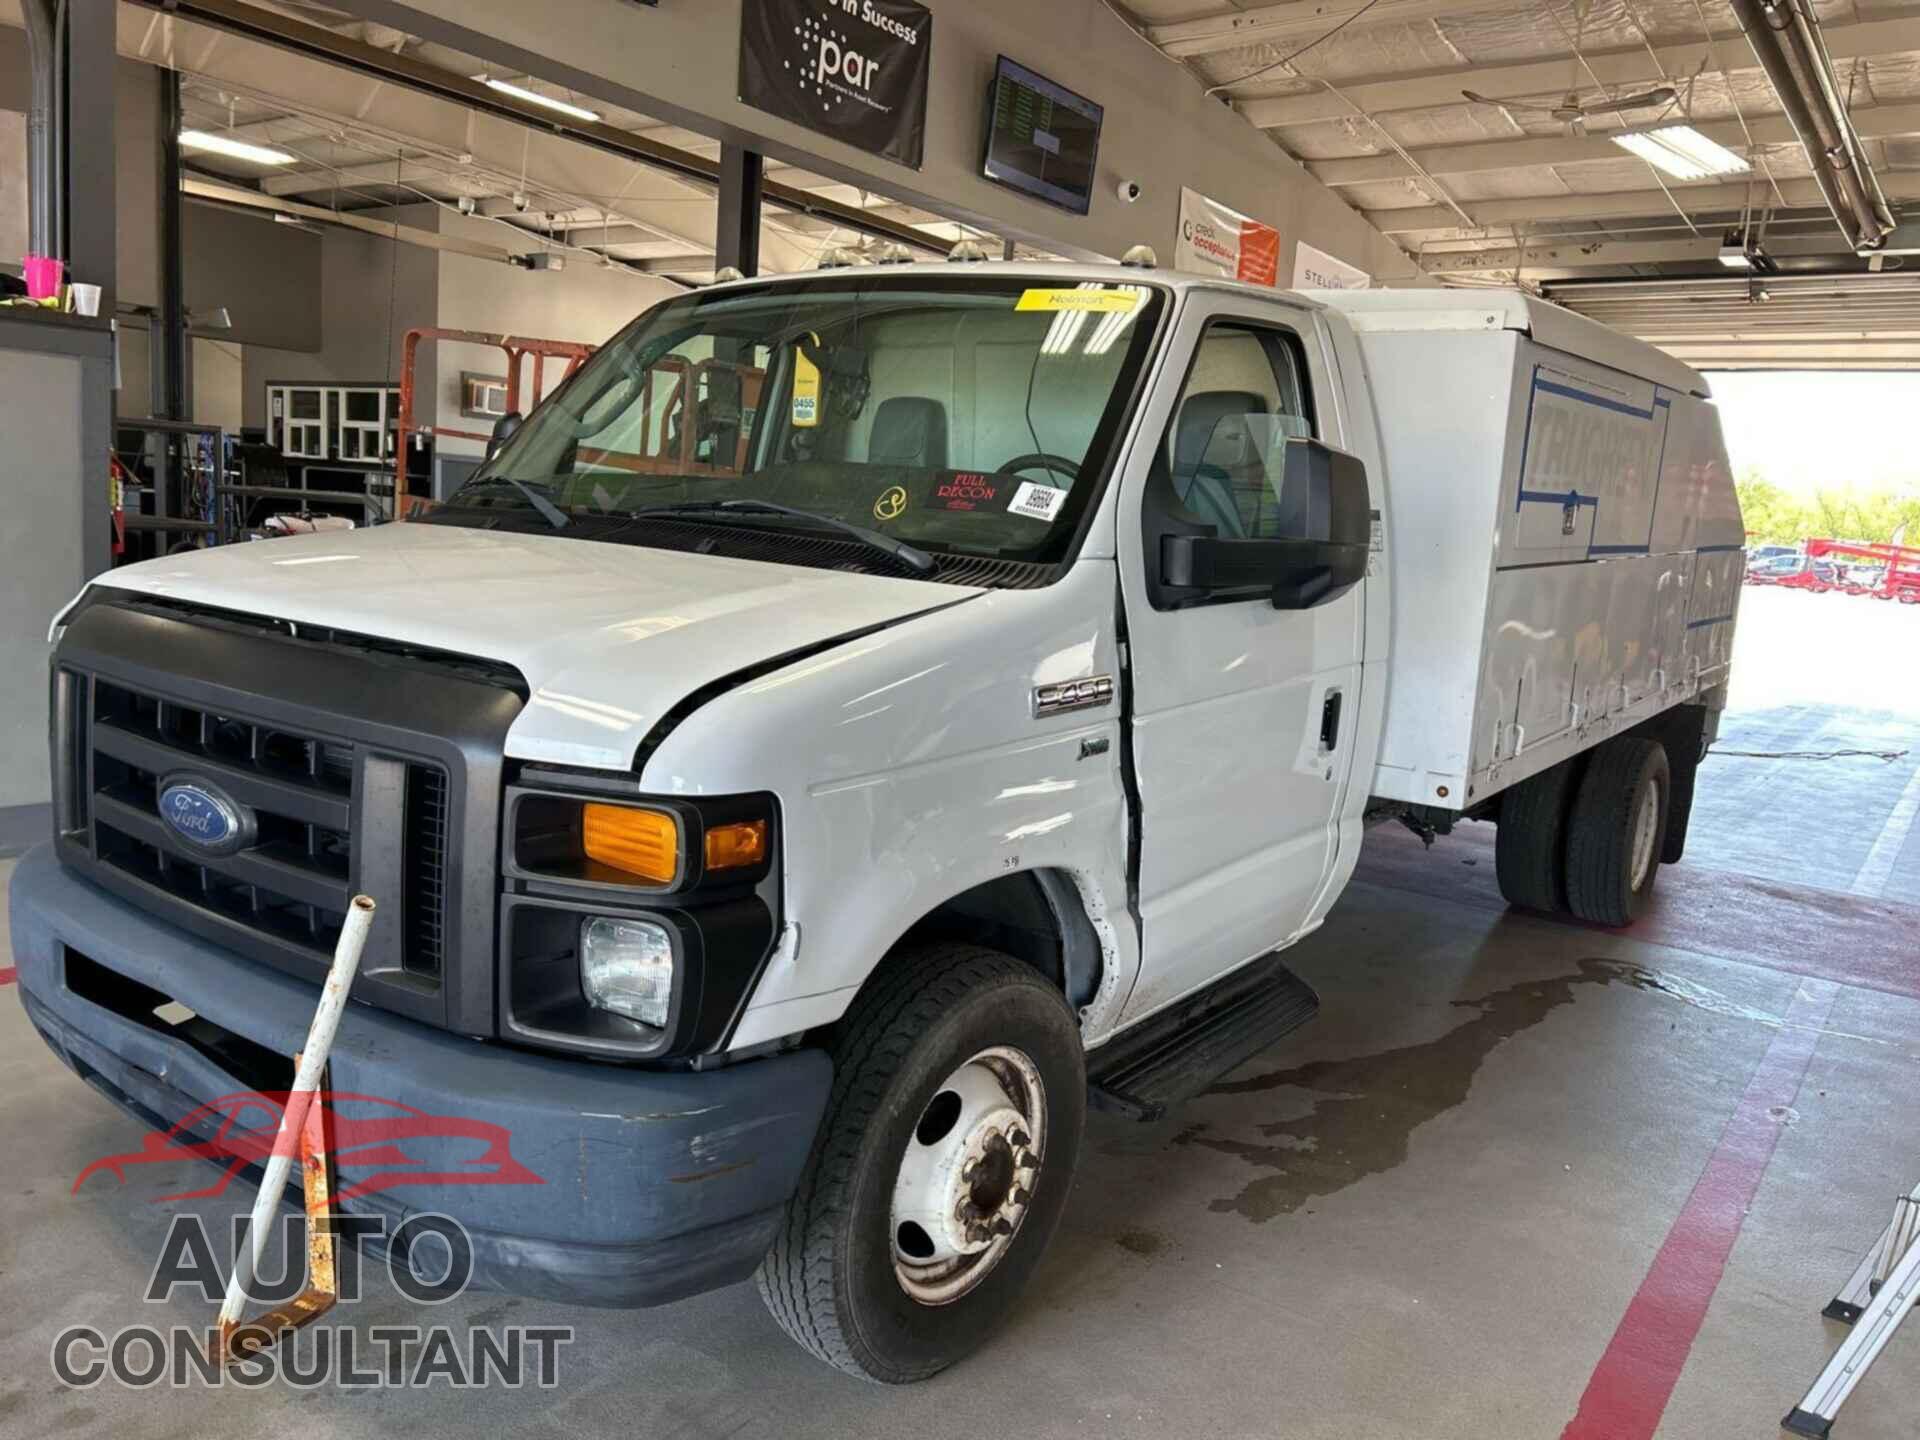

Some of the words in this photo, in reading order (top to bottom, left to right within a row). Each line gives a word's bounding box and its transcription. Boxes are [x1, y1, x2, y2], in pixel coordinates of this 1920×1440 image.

[861, 0, 917, 45] Success
[817, 37, 880, 91] par
[937, 486, 997, 501] RECON
[954, 473, 986, 487] FULL
[171, 793, 213, 833] Ford
